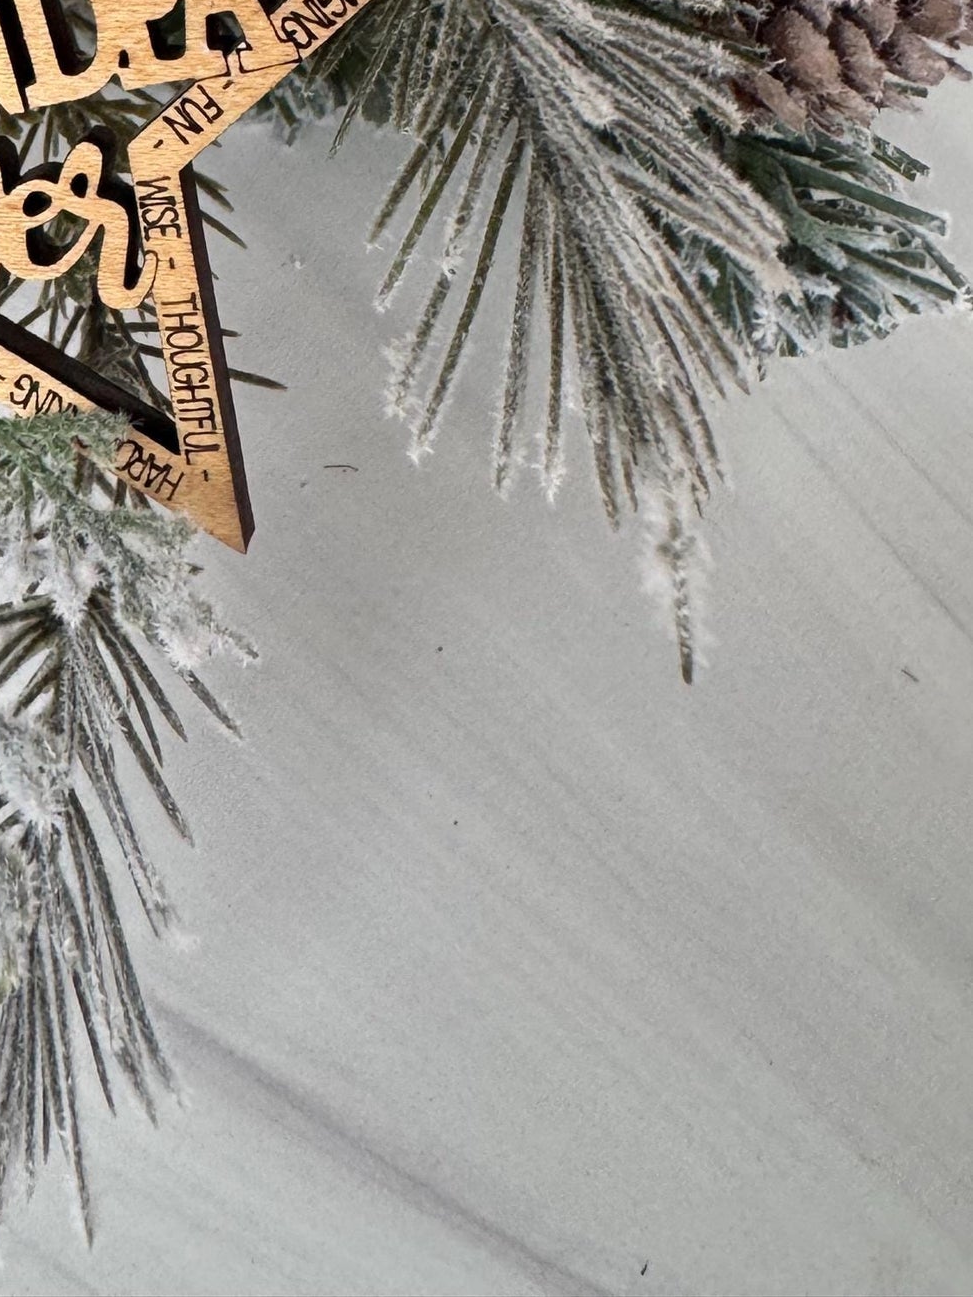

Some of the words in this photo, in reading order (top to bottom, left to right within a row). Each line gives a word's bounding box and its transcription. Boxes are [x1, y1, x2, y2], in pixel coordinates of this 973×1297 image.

[163, 85, 224, 145] FUN
[136, 175, 182, 242] WISE
[161, 292, 221, 465] THOUGHTFUL
